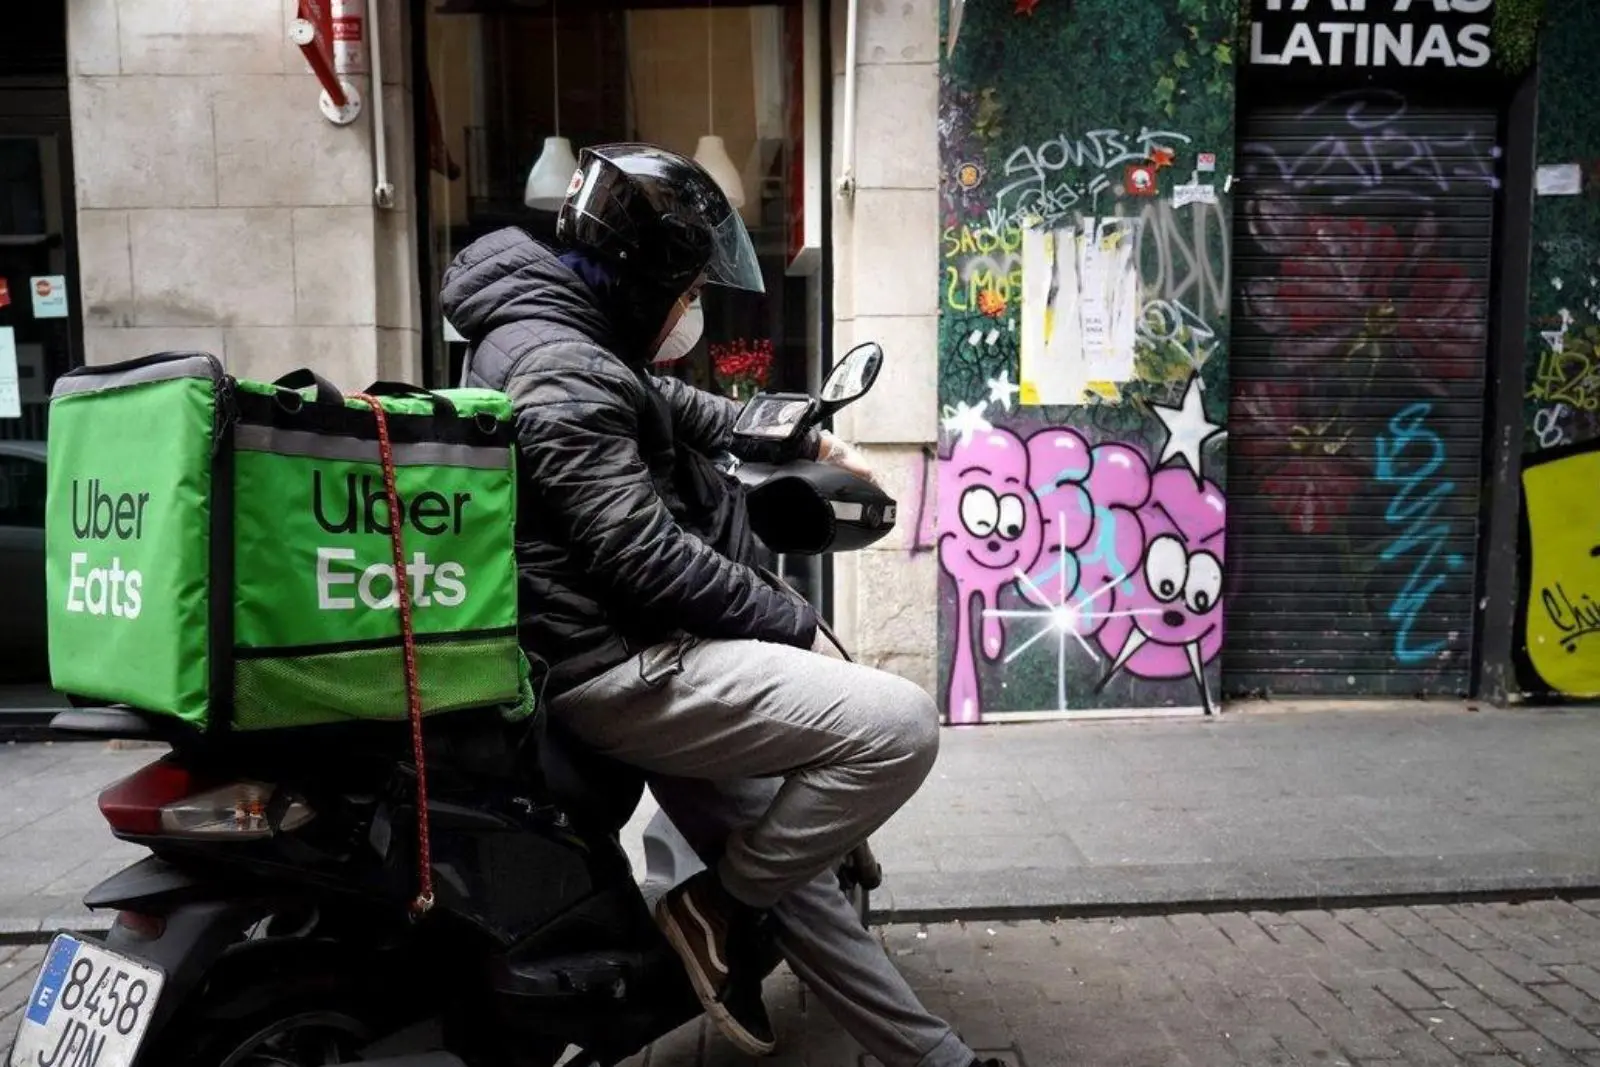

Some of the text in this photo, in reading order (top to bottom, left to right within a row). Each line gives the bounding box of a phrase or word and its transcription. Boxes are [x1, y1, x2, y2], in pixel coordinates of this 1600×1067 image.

[1250, 21, 1492, 68] LATINAS
[72, 479, 150, 540] Uber
[313, 469, 472, 537] Uber
[66, 552, 143, 619] Eats
[316, 546, 467, 610] Eats
[60, 957, 149, 1036] 8458
